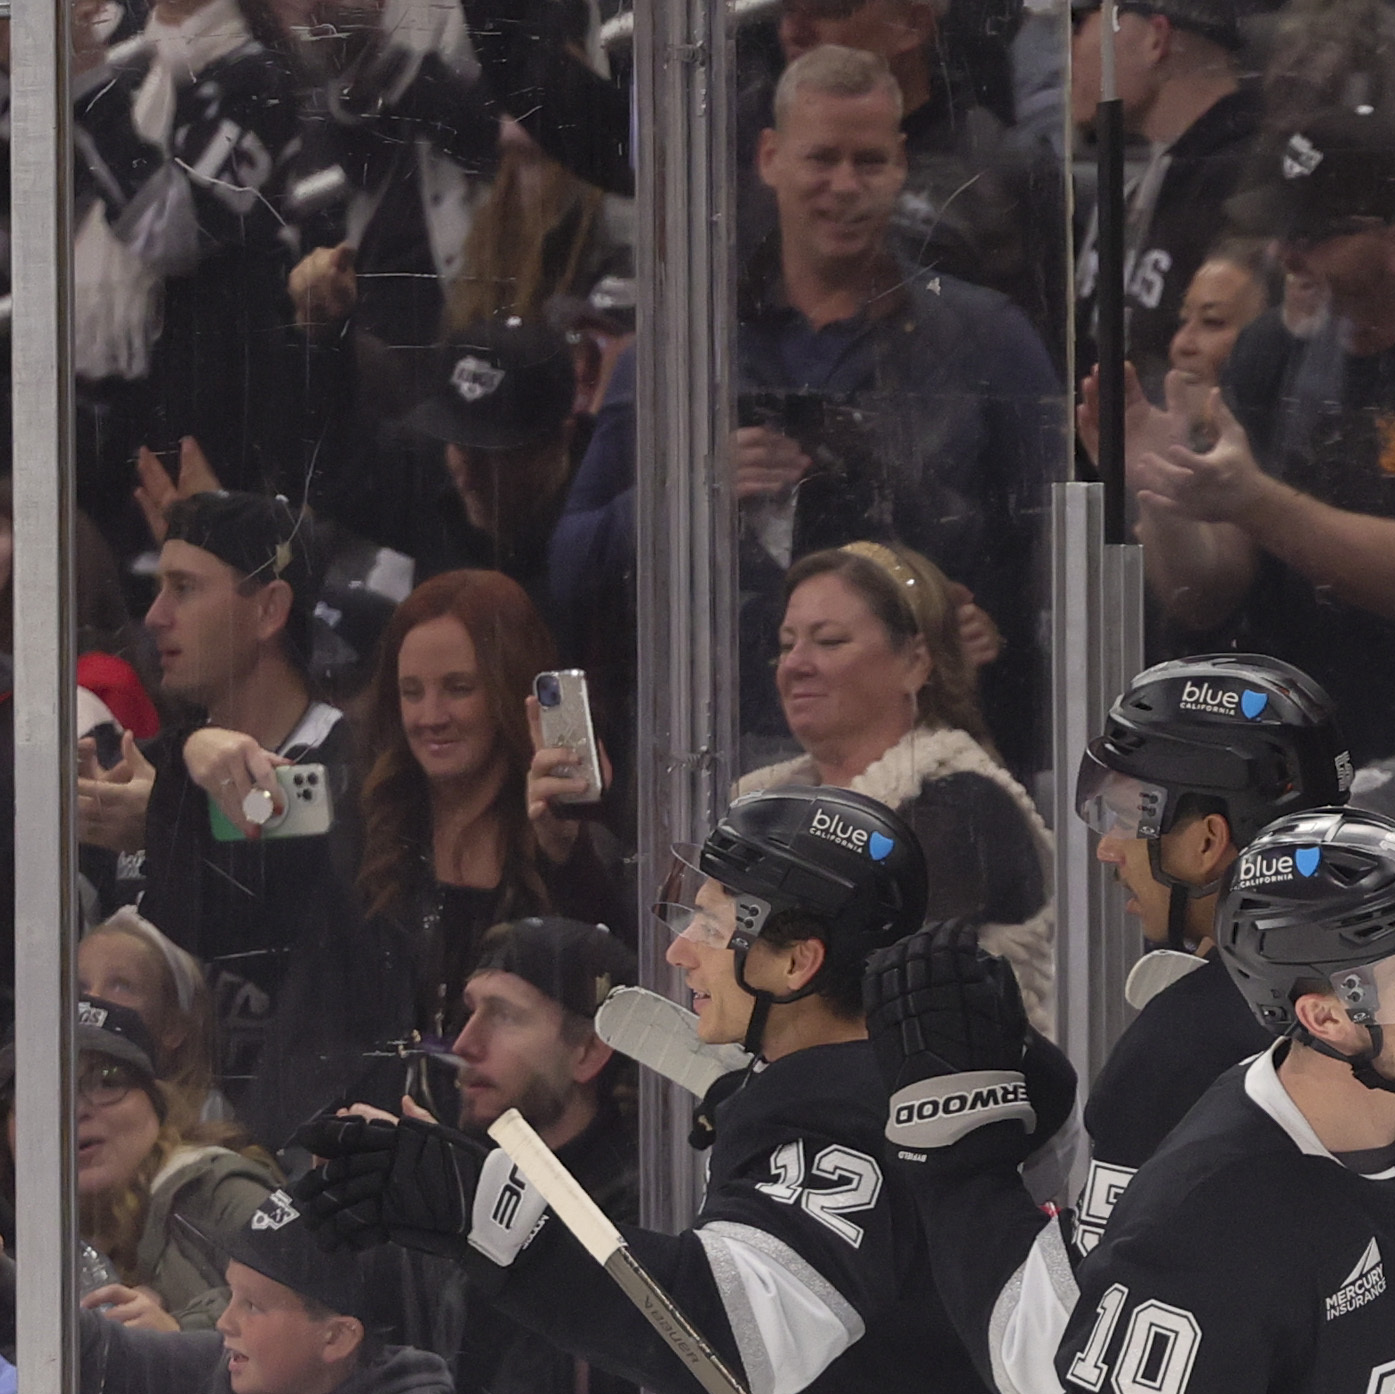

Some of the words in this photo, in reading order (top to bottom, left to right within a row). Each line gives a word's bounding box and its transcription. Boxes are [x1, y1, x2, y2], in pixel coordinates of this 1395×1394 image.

[1181, 681, 1239, 708] blue
[1179, 702, 1236, 716] CALIFORNIA
[809, 827, 863, 853] CALIFORNIA
[812, 808, 868, 846] blue
[1239, 854, 1294, 880] blue
[1239, 873, 1294, 889] CALIFORNIA
[894, 1082, 1030, 1128] ERWOOD
[754, 1138, 884, 1249] 12
[1325, 1262, 1384, 1310] MERCURY
